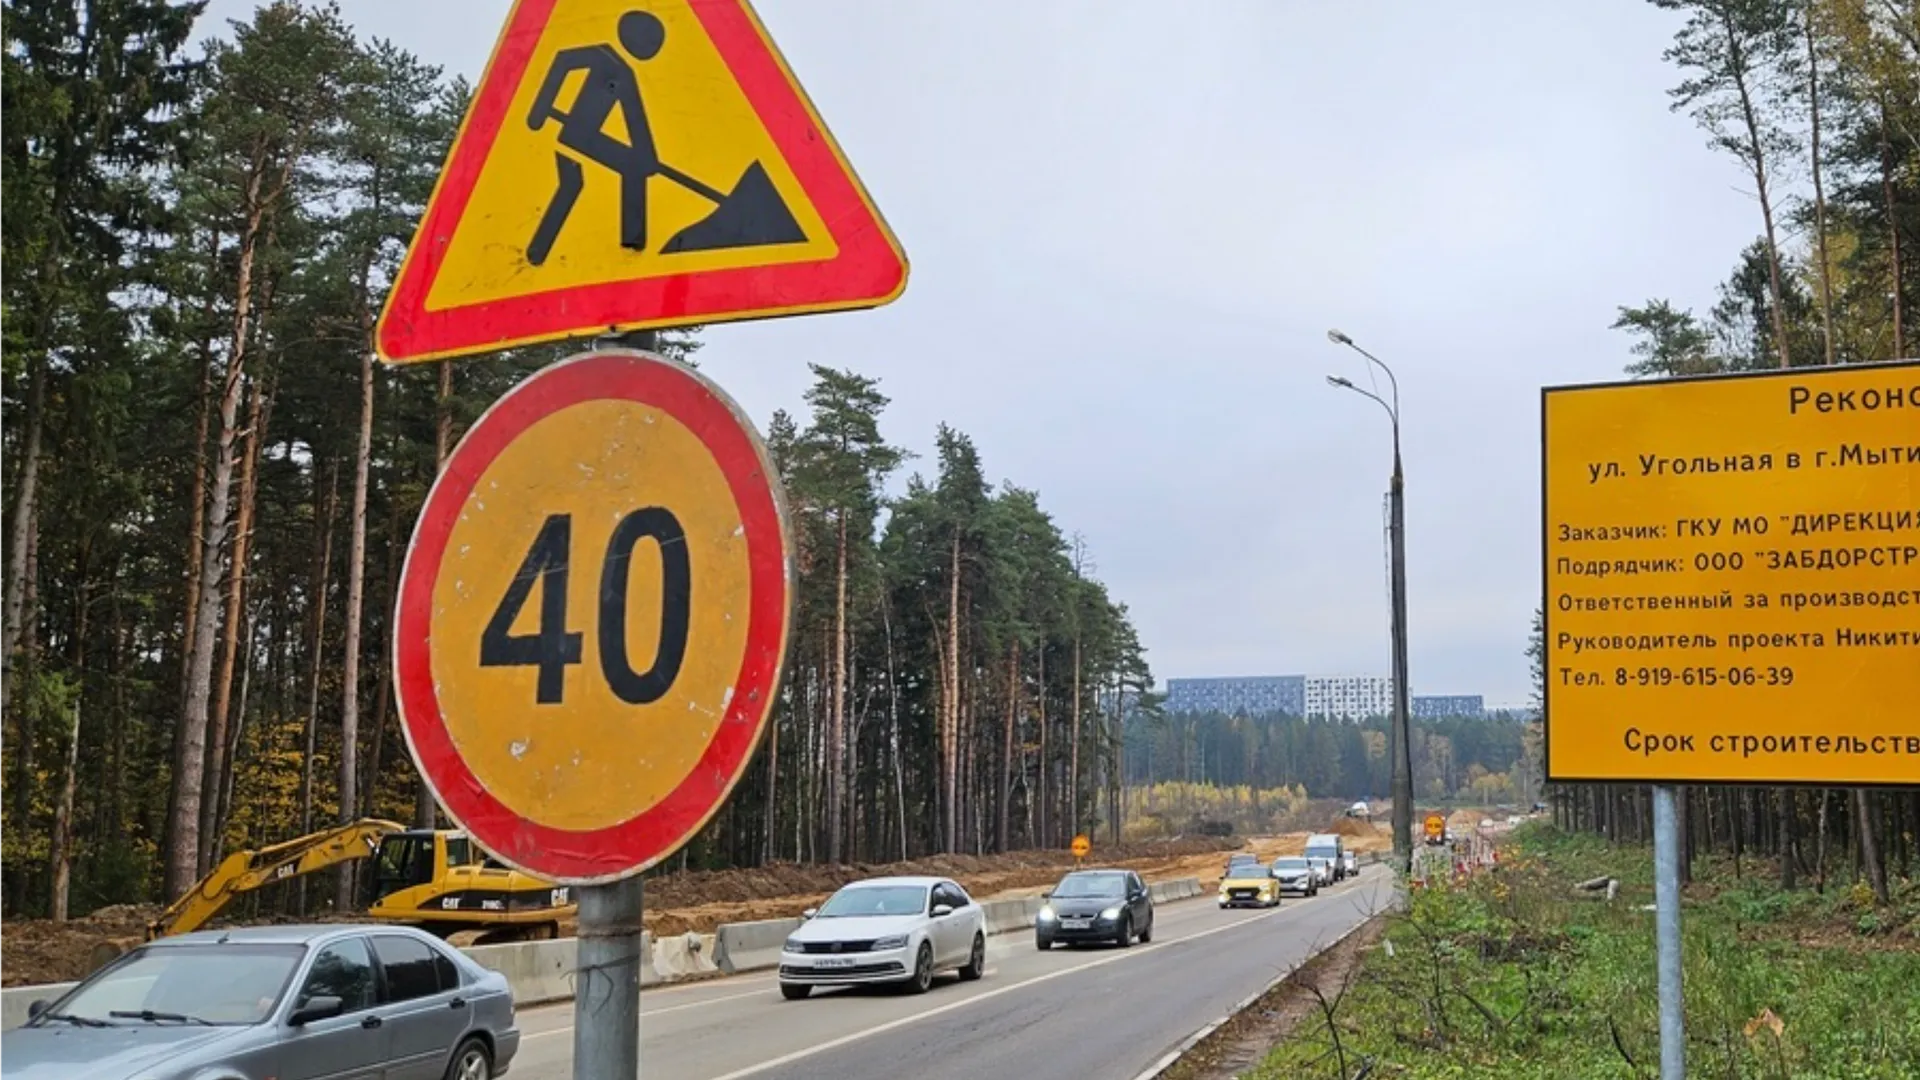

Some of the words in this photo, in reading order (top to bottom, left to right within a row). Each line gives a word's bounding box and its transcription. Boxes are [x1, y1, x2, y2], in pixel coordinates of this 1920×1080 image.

[1588, 463, 1626, 484] ул.
[1638, 453, 1773, 476] Угольная
[1786, 452, 1801, 470] в
[1558, 523, 1667, 543] Заказчик:
[1676, 517, 1722, 537] ГКУ
[1732, 515, 1769, 535] МО
[1557, 556, 1684, 578] Подрядчик:
[1694, 551, 1744, 572] ООО
[479, 505, 691, 705] 40
[1557, 590, 1733, 612] Ответственный
[1743, 593, 1769, 609] за
[1557, 632, 1718, 654] Руководитель
[1728, 632, 1825, 652] проекта
[1559, 667, 1605, 686] Тел.
[1615, 666, 1794, 686] 8-919-615-06-39
[1623, 728, 1695, 757] Срок
[1709, 734, 1920, 758] строительств
